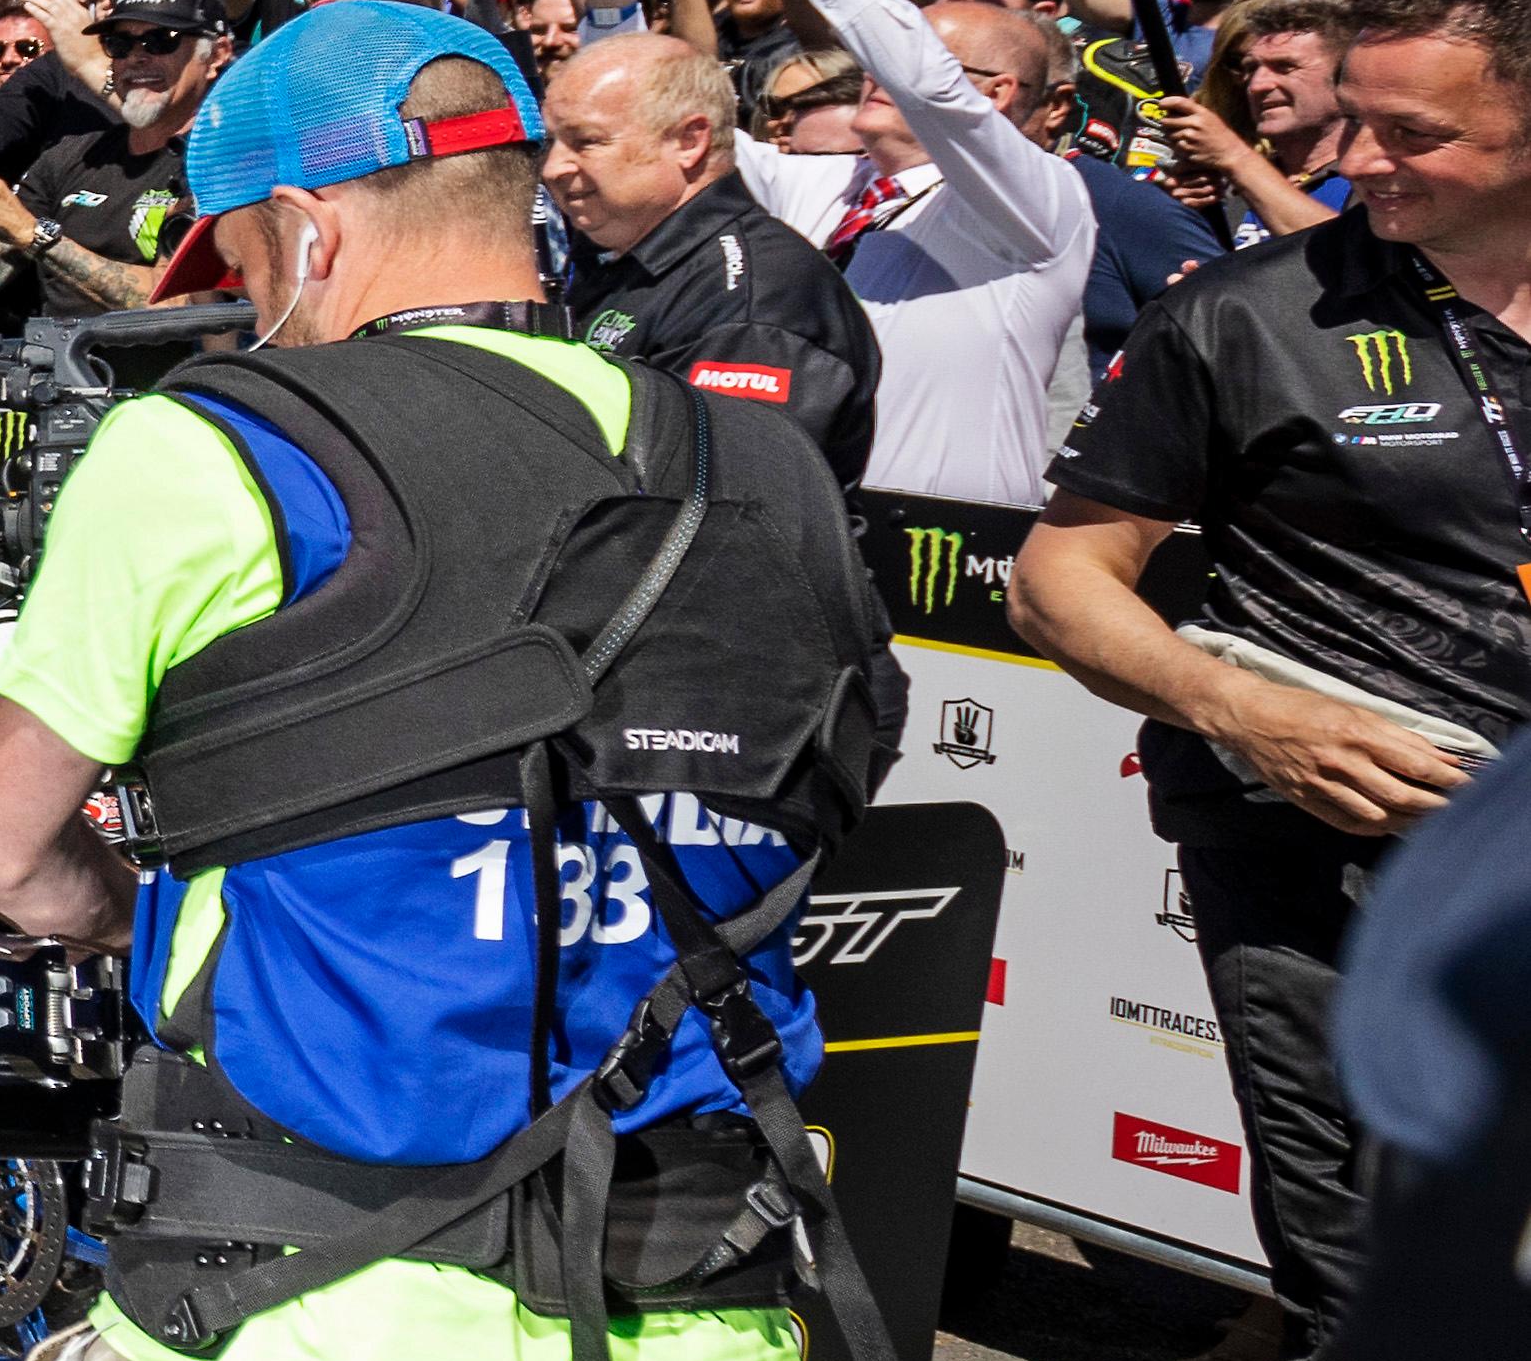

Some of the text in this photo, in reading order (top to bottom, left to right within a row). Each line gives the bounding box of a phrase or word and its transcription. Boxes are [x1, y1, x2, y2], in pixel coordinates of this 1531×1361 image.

[390, 306, 467, 327] MONSTER
[693, 368, 781, 394] MOTUL
[1337, 402, 1443, 425] FHO
[1379, 439, 1444, 448] MOTORSPORT
[623, 726, 740, 756] STEADICAM
[1110, 996, 1222, 1043] IOMTTRACES.
[1135, 1128, 1220, 1162] Milwaukee
